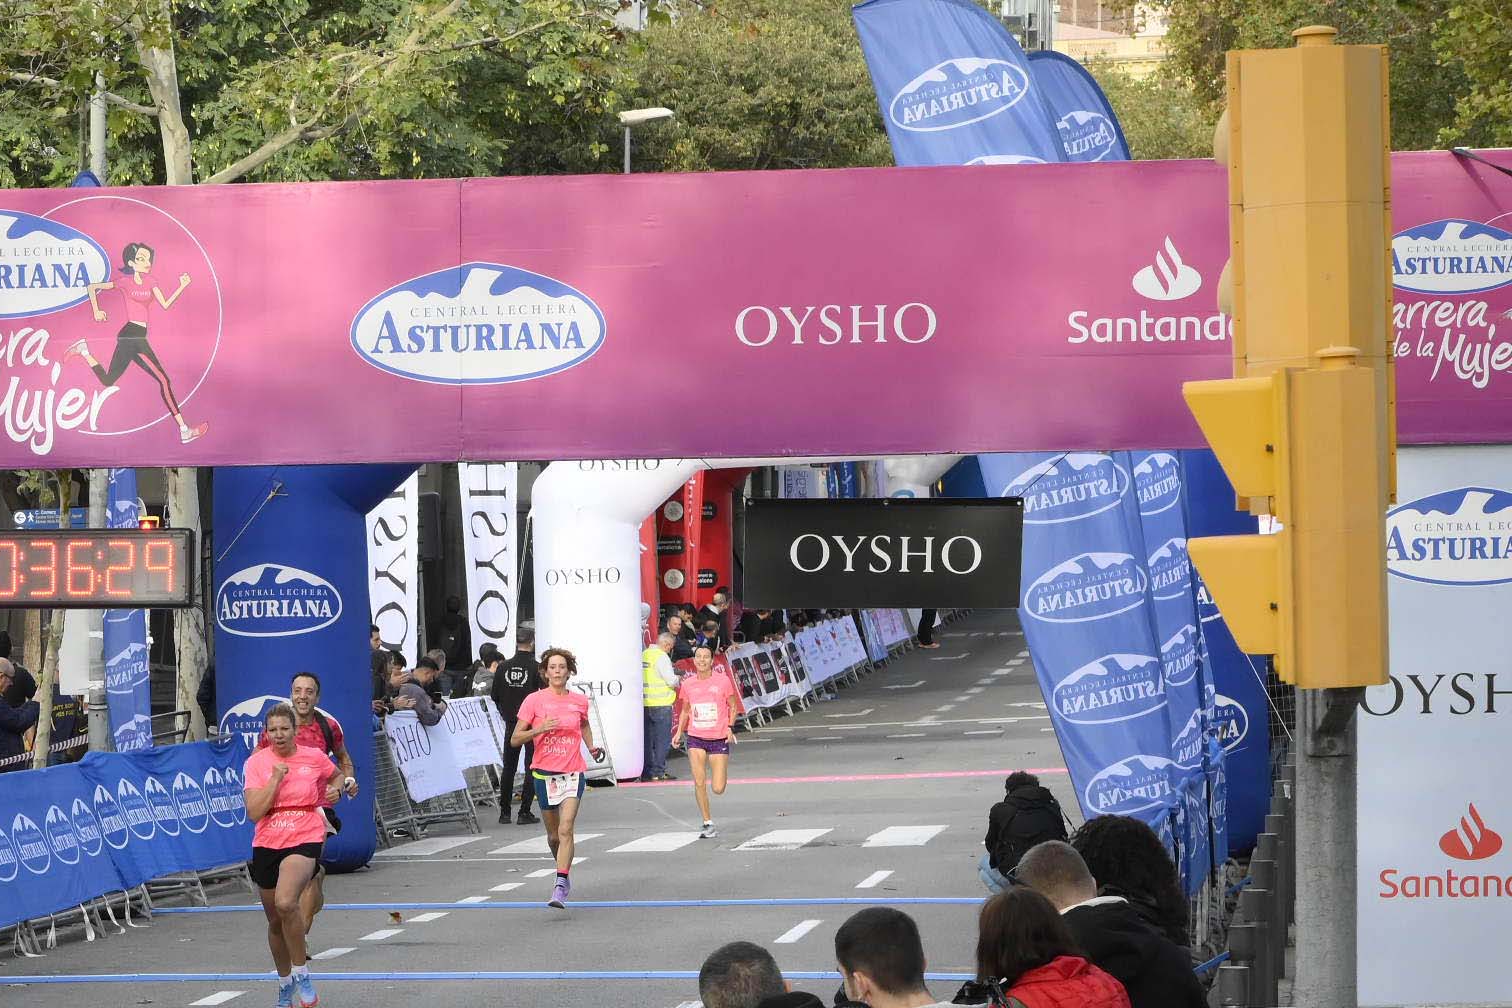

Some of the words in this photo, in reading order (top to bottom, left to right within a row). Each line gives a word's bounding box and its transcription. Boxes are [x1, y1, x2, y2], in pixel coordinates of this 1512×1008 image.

[13, 246, 86, 258] LECHERA
[409, 307, 489, 319] CENTRAL
[496, 303, 578, 317] LECHERA
[734, 302, 937, 347] OYSHO
[1393, 300, 1488, 329] arrera
[370, 309, 586, 355] ASTURIANA
[1067, 309, 1233, 345] Santand
[1416, 330, 1434, 357] la
[1430, 323, 1512, 389] Muje
[1414, 521, 1481, 532] CENTRAL
[789, 533, 983, 575] OYSHO
[1385, 524, 1512, 562] ASTURI
[545, 566, 621, 586] OYSHO
[220, 593, 332, 621] ASTURIANA
[233, 588, 274, 597] CENTRAL
[279, 587, 328, 597] LECHERA
[510, 671, 523, 680] BP
[1359, 672, 1512, 717] OYSH
[234, 721, 264, 729] CENTR
[392, 720, 432, 765] SHO
[1378, 868, 1512, 900] Santan
